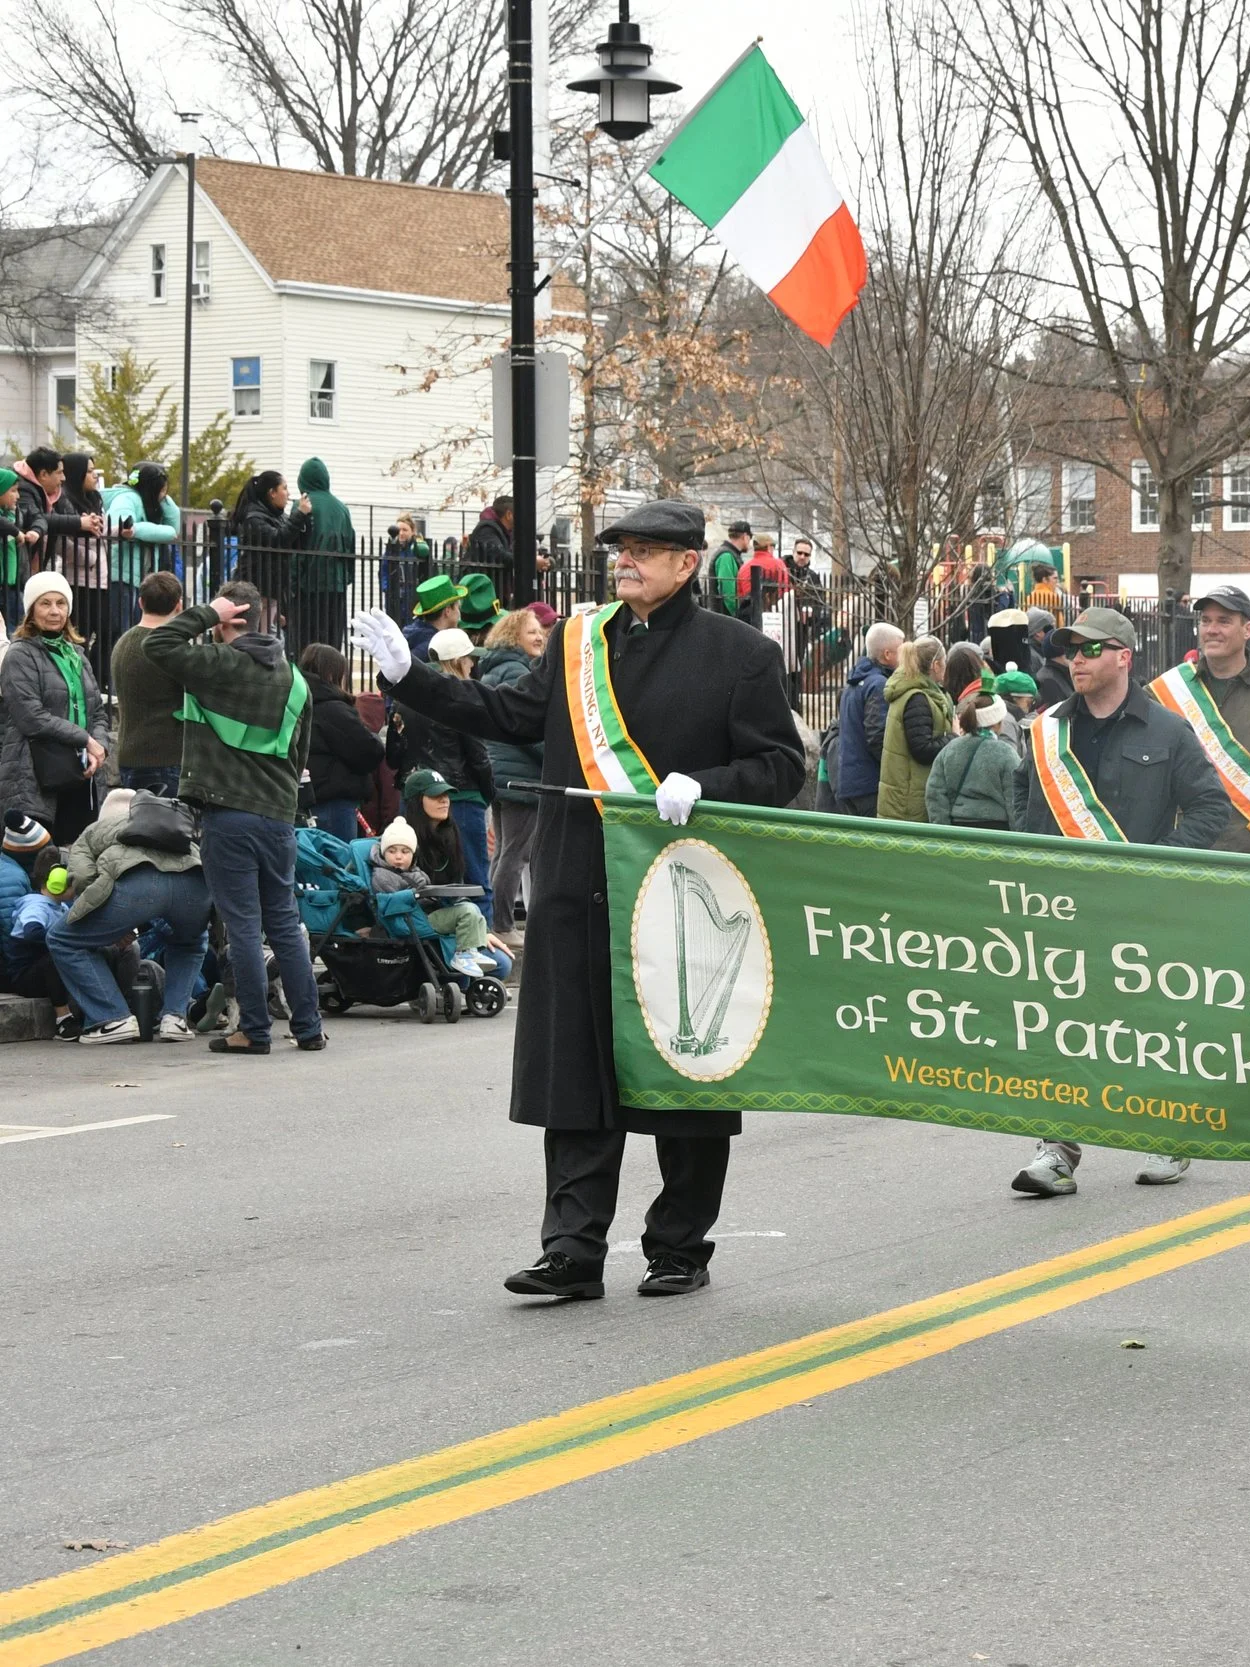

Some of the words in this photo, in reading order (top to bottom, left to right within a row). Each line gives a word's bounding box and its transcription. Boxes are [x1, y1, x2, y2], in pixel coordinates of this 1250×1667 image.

[583, 642, 598, 723] OSSINING,
[592, 724, 607, 749] NY
[988, 879, 1078, 921] The
[803, 904, 1087, 1000] Friendly
[836, 995, 889, 1033] of
[906, 988, 998, 1048] St.
[884, 1054, 1090, 1108] Westchester
[1101, 1084, 1227, 1132] County
